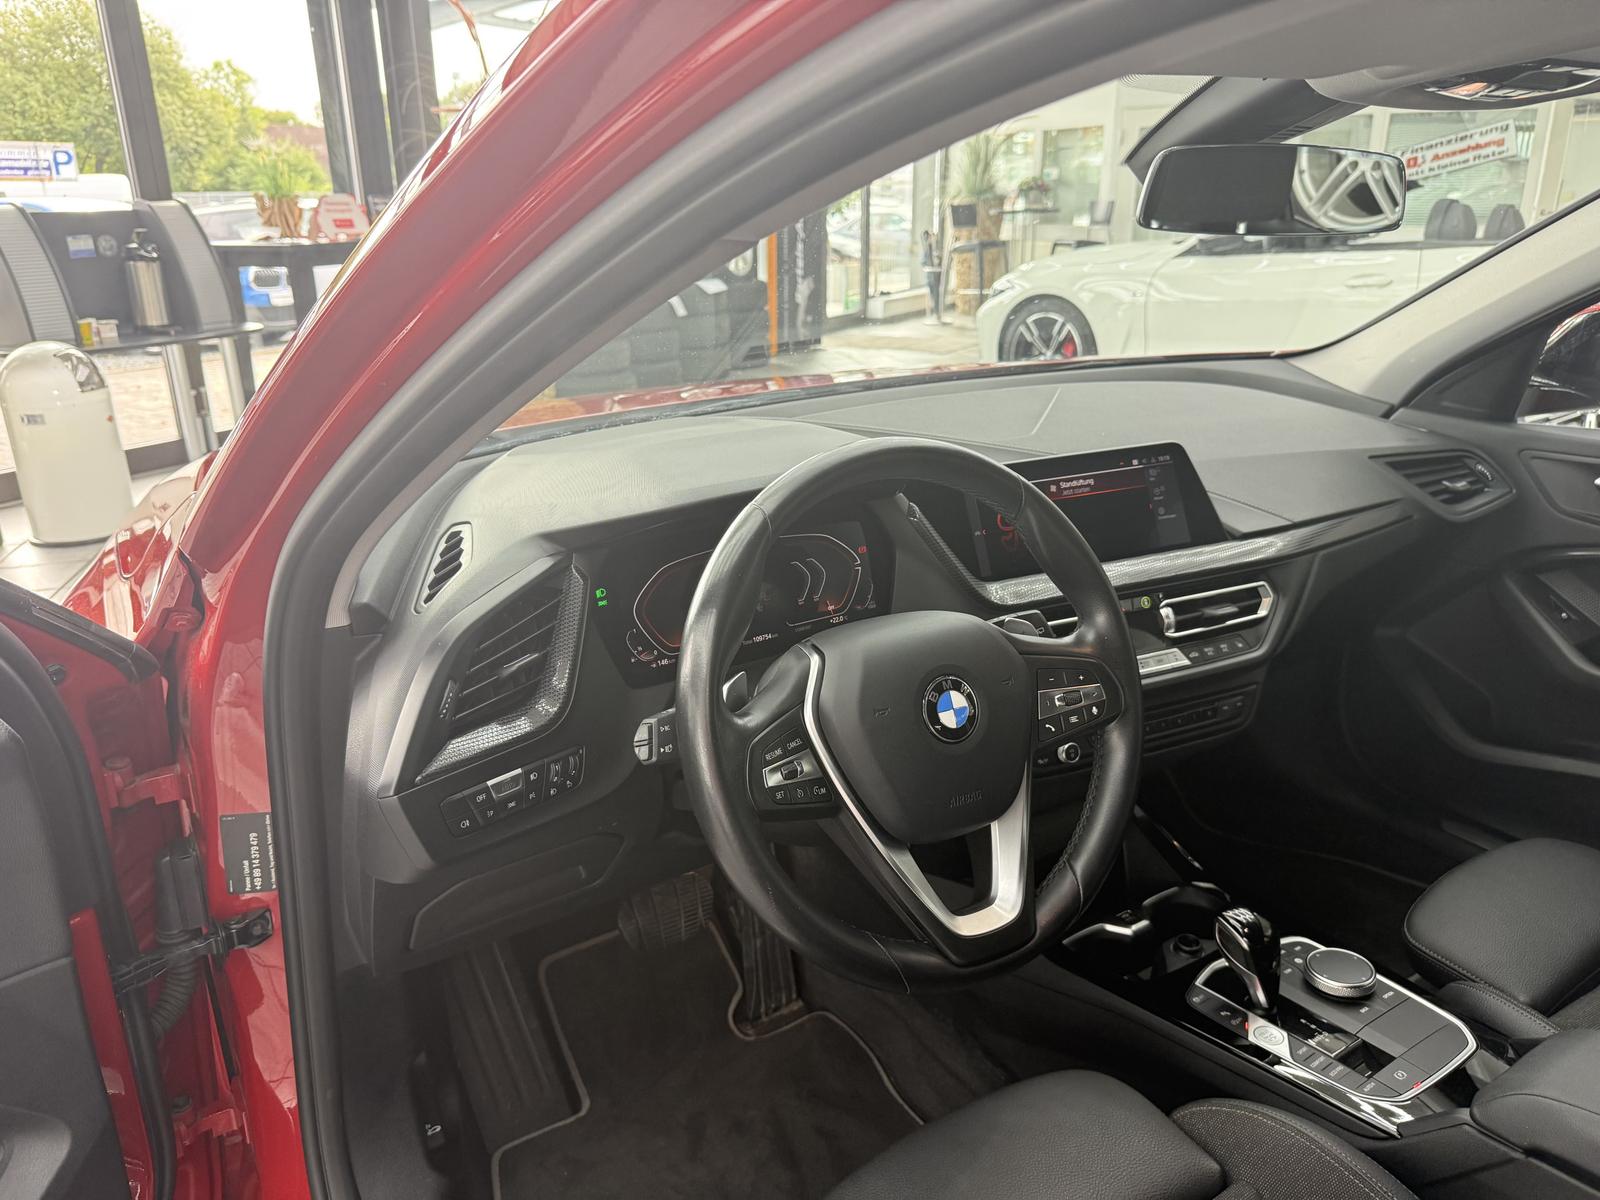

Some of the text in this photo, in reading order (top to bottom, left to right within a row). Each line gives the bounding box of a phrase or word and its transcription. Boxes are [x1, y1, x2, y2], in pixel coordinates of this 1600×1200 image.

[53, 150, 73, 175] P
[929, 679, 971, 703] BMW
[787, 738, 803, 750] CANCEL
[765, 747, 783, 760] RESUME
[476, 793, 487, 802] OFF
[775, 790, 785, 800] SET
[249, 832, 262, 890] +49 89 14 379 479
